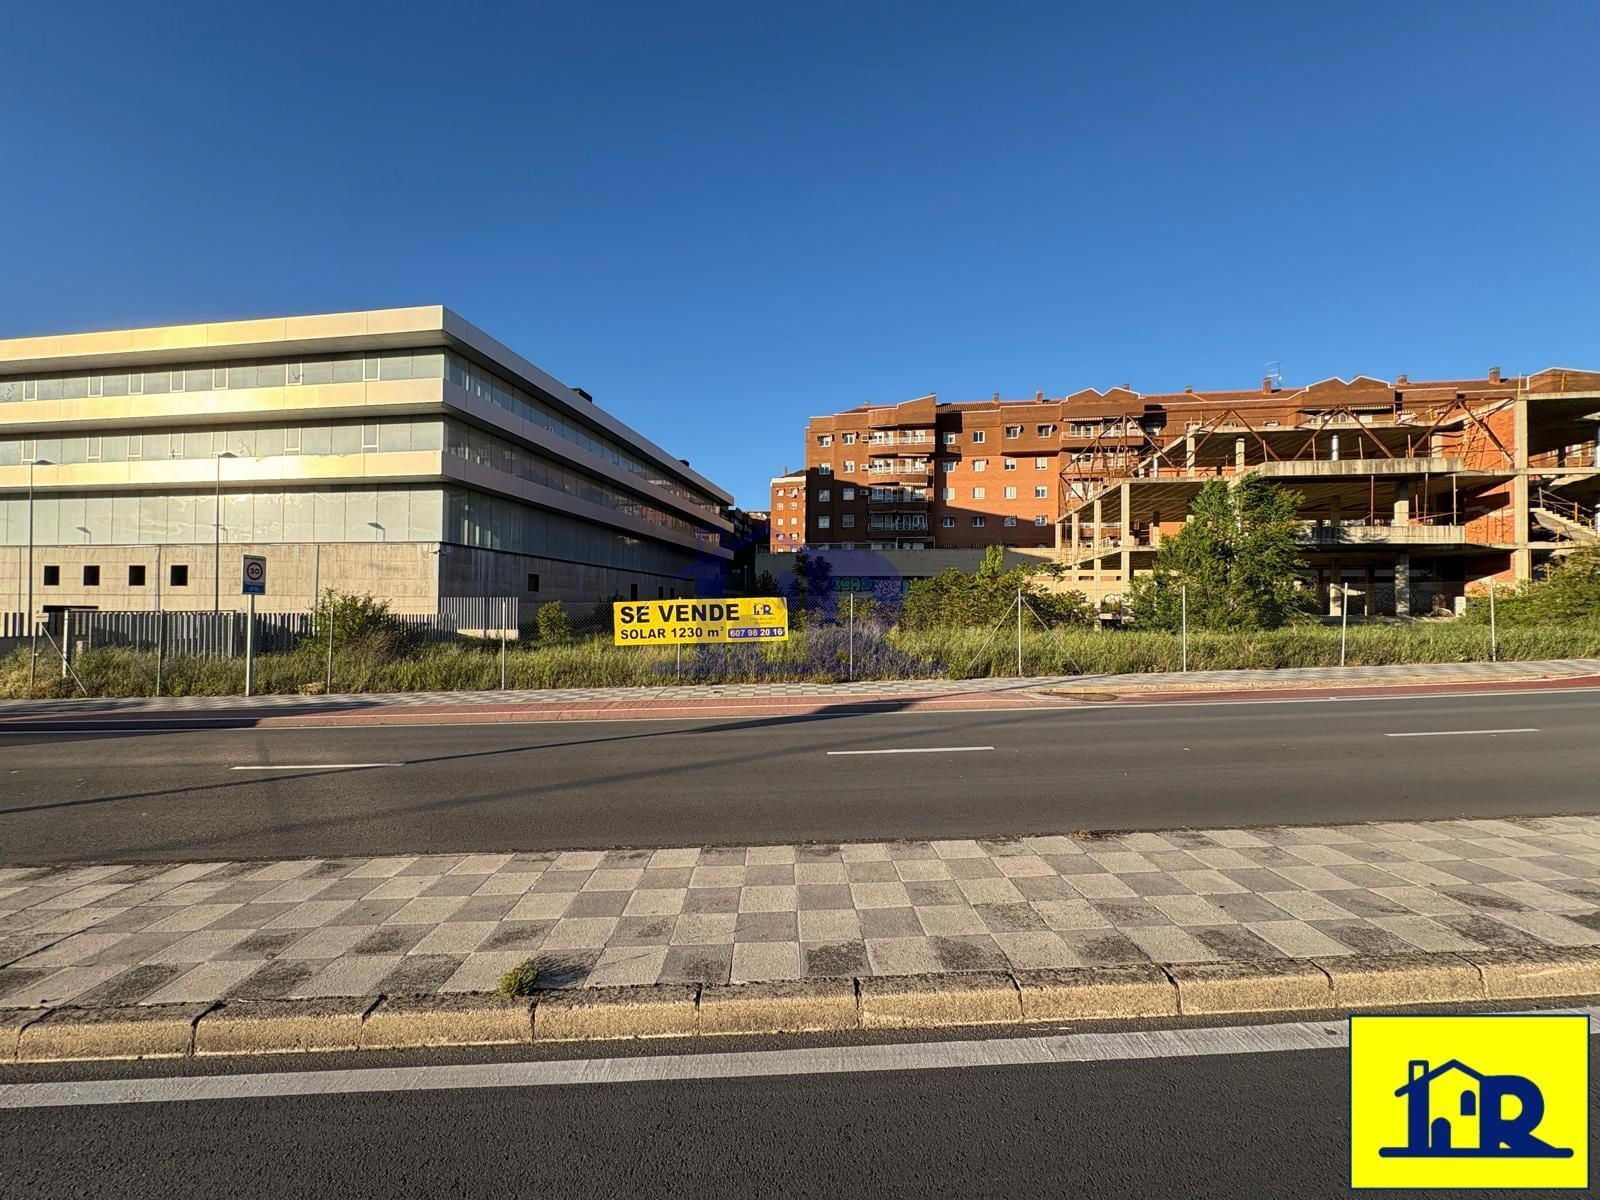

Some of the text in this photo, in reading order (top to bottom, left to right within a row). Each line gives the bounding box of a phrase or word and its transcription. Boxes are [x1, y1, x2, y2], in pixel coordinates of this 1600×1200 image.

[621, 603, 740, 624] SE VENDE
[621, 628, 666, 640] SOLAR
[671, 627, 703, 638] 1230
[730, 629, 745, 637] 607
[747, 629, 758, 637] 98
[760, 628, 770, 636] 20
